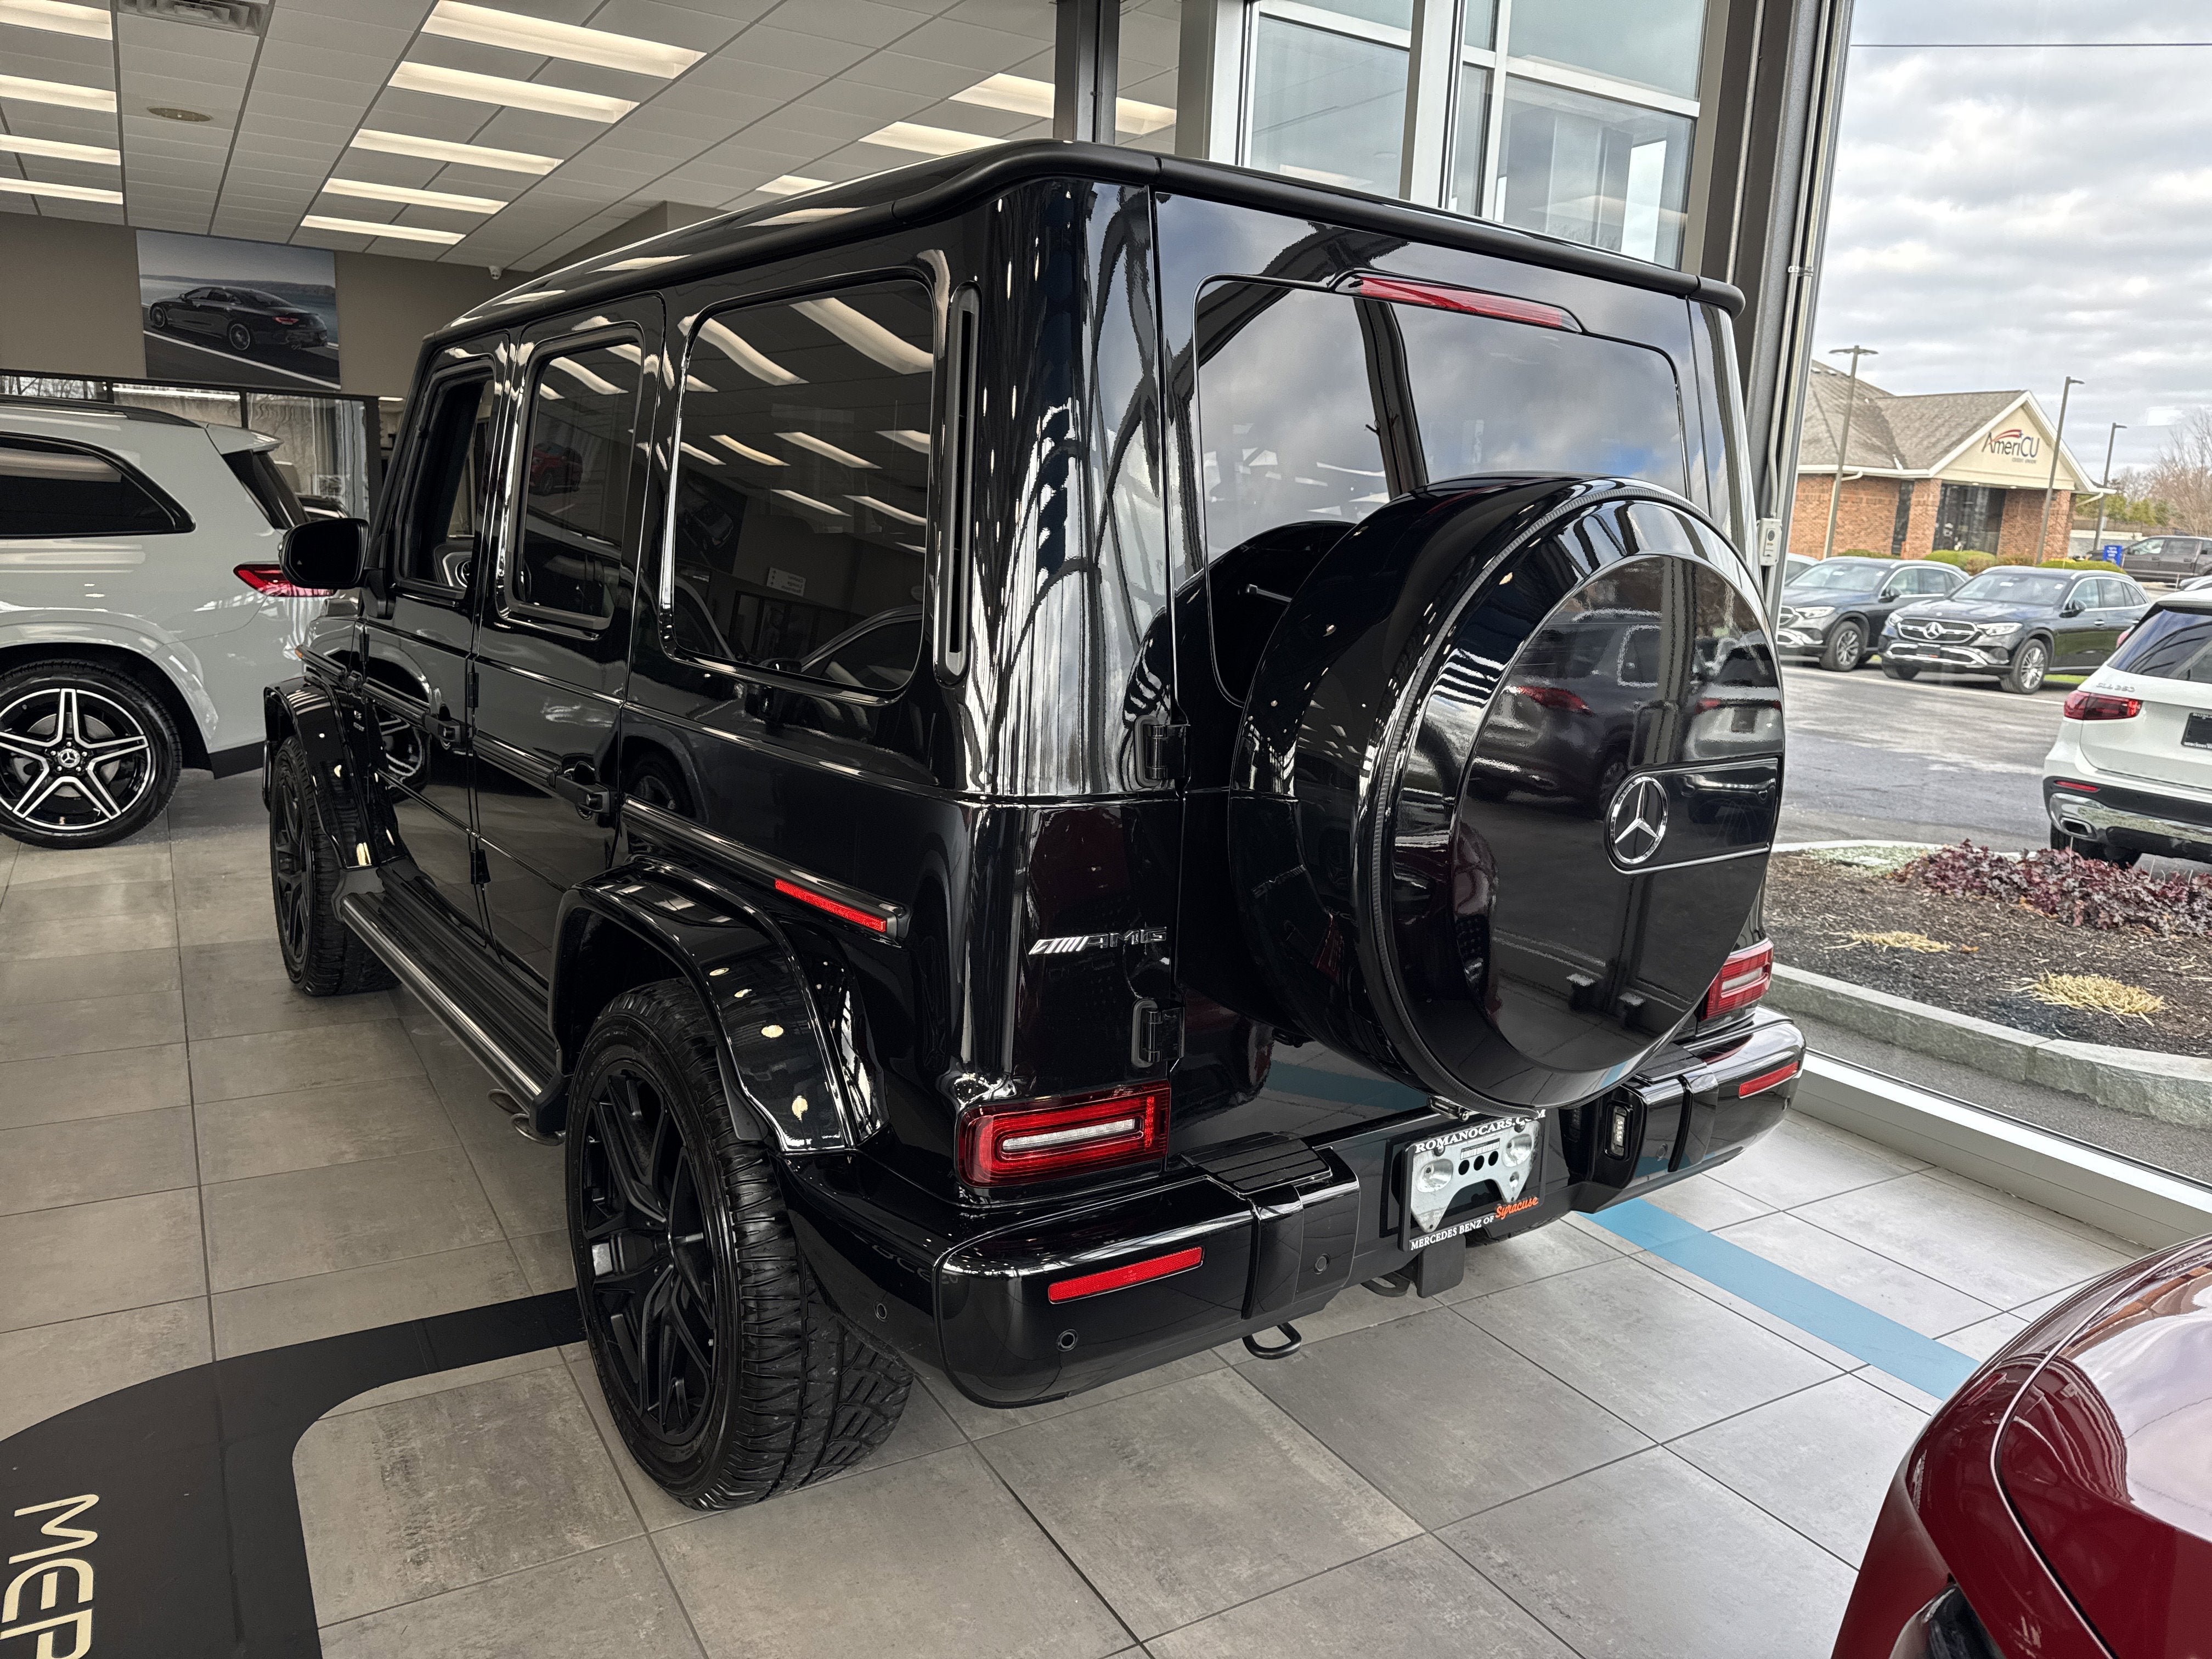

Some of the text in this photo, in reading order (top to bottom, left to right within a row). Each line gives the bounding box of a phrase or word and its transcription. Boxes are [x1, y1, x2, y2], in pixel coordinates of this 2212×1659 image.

[1981, 432, 2040, 458] AmeriCU
[1076, 926, 1167, 952] AMG
[1410, 1197, 1539, 1251] MERCEDES BENZ OF Syracuse
